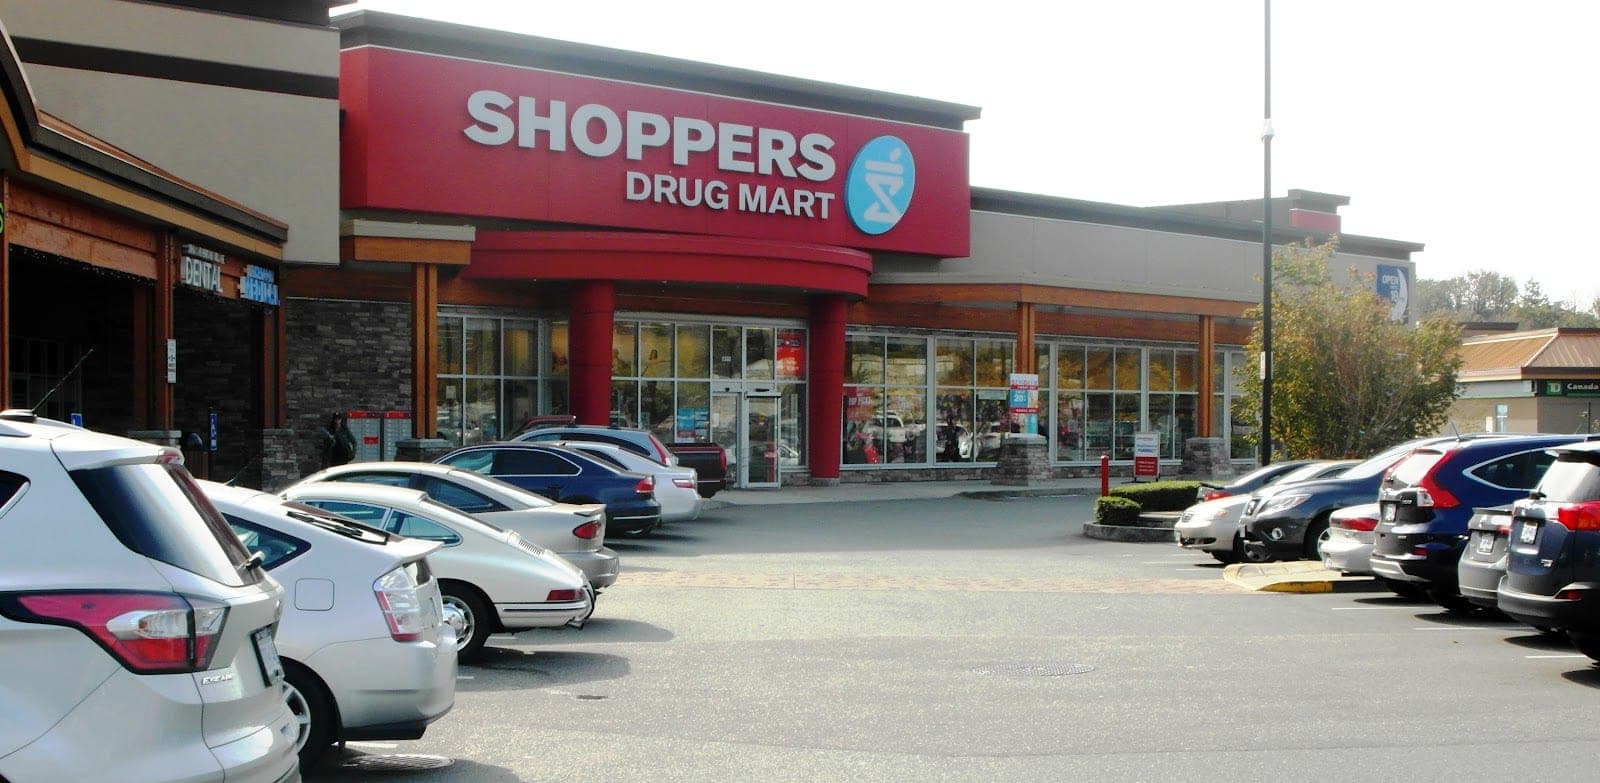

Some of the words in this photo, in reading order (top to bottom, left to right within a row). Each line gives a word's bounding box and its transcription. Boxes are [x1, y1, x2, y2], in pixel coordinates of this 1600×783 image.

[463, 90, 836, 182] SHOPPERS
[626, 171, 729, 211] DRUG
[739, 183, 835, 220] MART
[184, 256, 223, 293] DENTAL
[1549, 383, 1561, 393] TD
